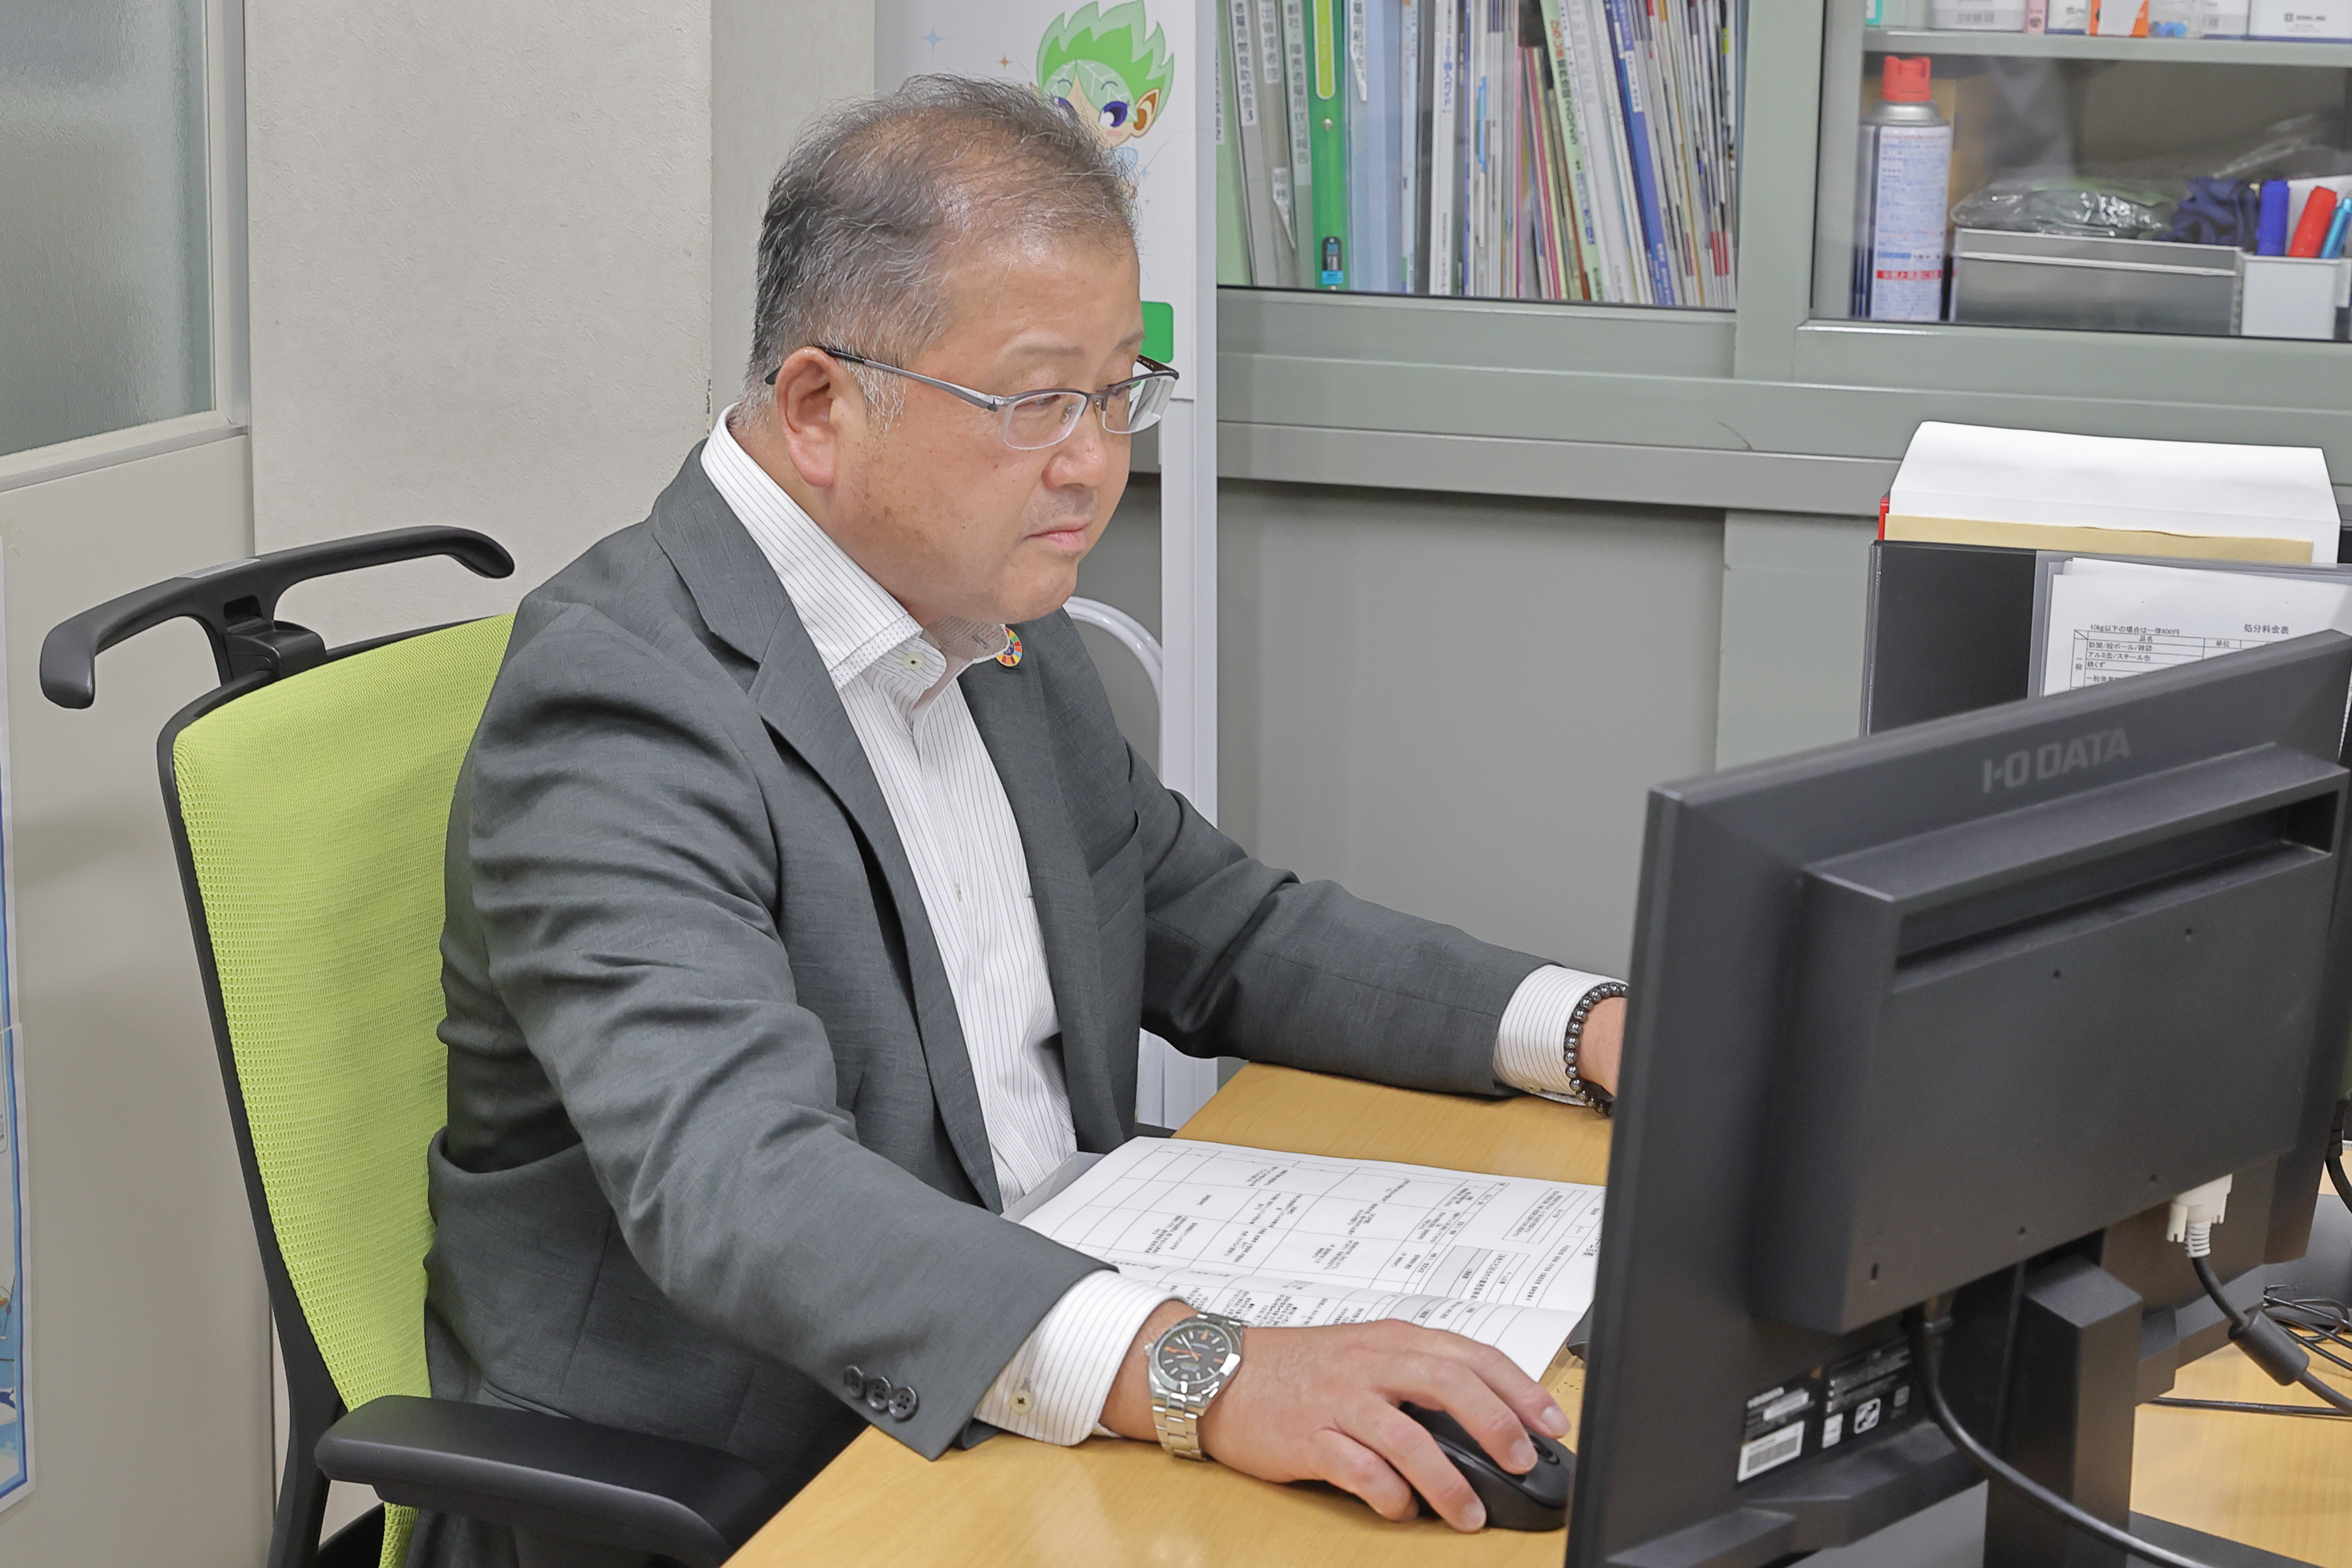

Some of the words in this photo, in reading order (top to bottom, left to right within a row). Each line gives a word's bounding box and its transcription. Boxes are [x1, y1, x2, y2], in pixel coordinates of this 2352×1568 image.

[2244, 623, 2290, 635] 処分料金表
[2035, 726, 2131, 780] DATA
